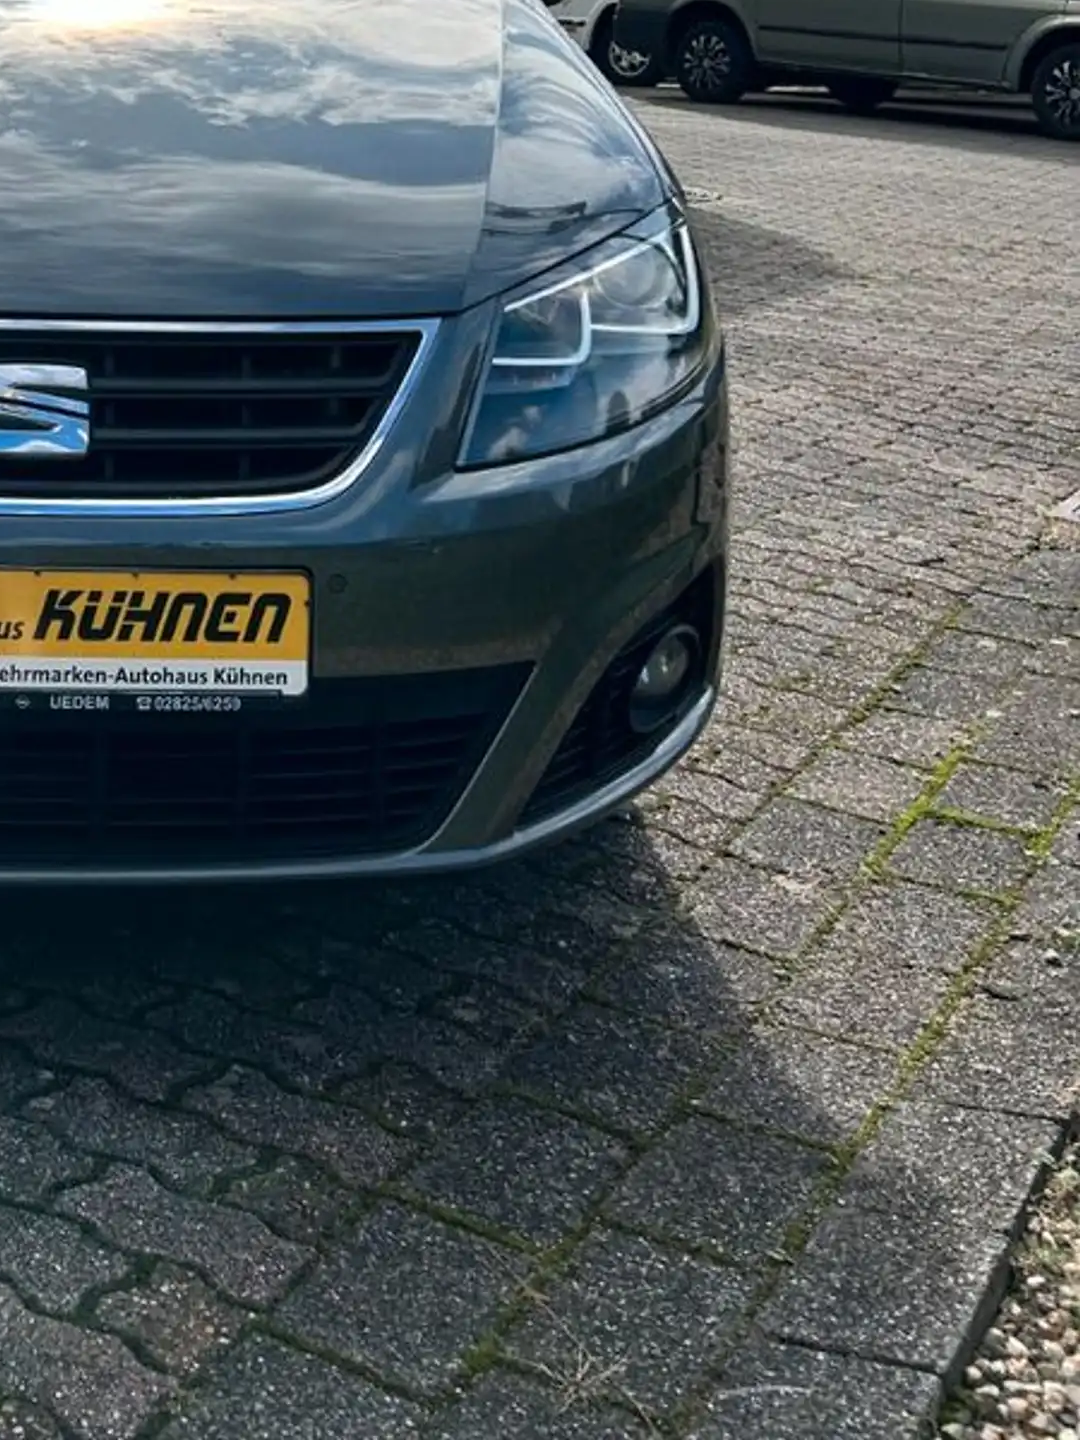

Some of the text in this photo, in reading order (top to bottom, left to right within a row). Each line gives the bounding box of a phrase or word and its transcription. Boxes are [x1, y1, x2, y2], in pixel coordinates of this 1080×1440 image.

[33, 588, 293, 643] KÜHNEN
[213, 665, 289, 687] Kühnen
[49, 695, 110, 710] UEDEM
